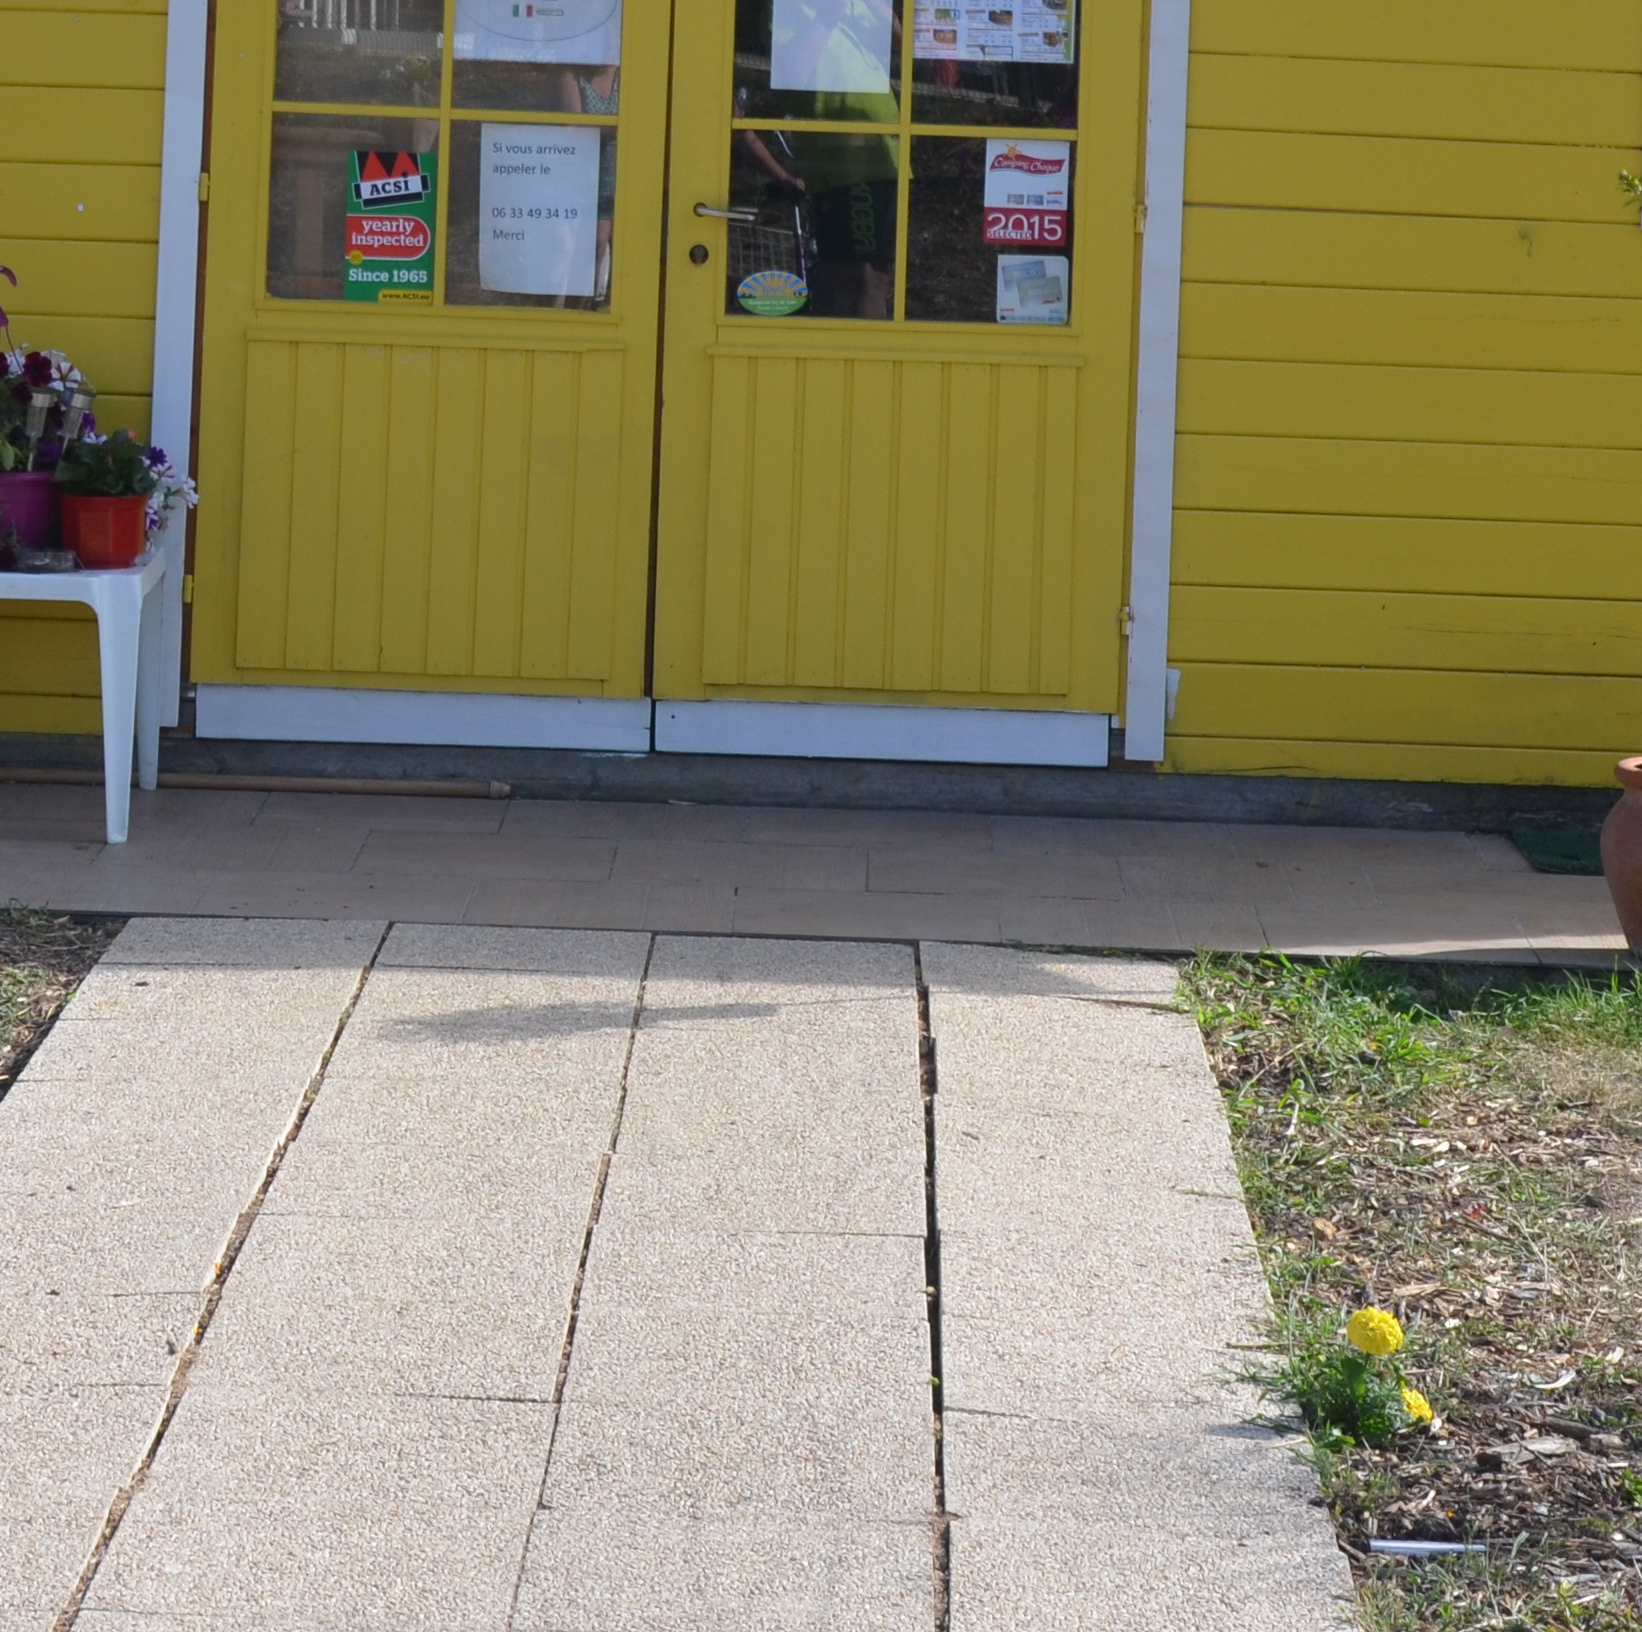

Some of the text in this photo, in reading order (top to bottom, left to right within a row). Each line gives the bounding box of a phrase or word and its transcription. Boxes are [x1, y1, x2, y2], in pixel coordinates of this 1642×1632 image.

[493, 143, 576, 156] Si vous arrivez
[492, 164, 551, 175] appeler le
[369, 179, 410, 197] ACSI
[492, 207, 578, 220] 06 33 49 34 19
[362, 218, 414, 235] yearly
[987, 212, 1063, 241] 2015
[351, 232, 424, 248] inspected
[493, 229, 525, 241] Merci
[349, 269, 427, 284] Since 1965
